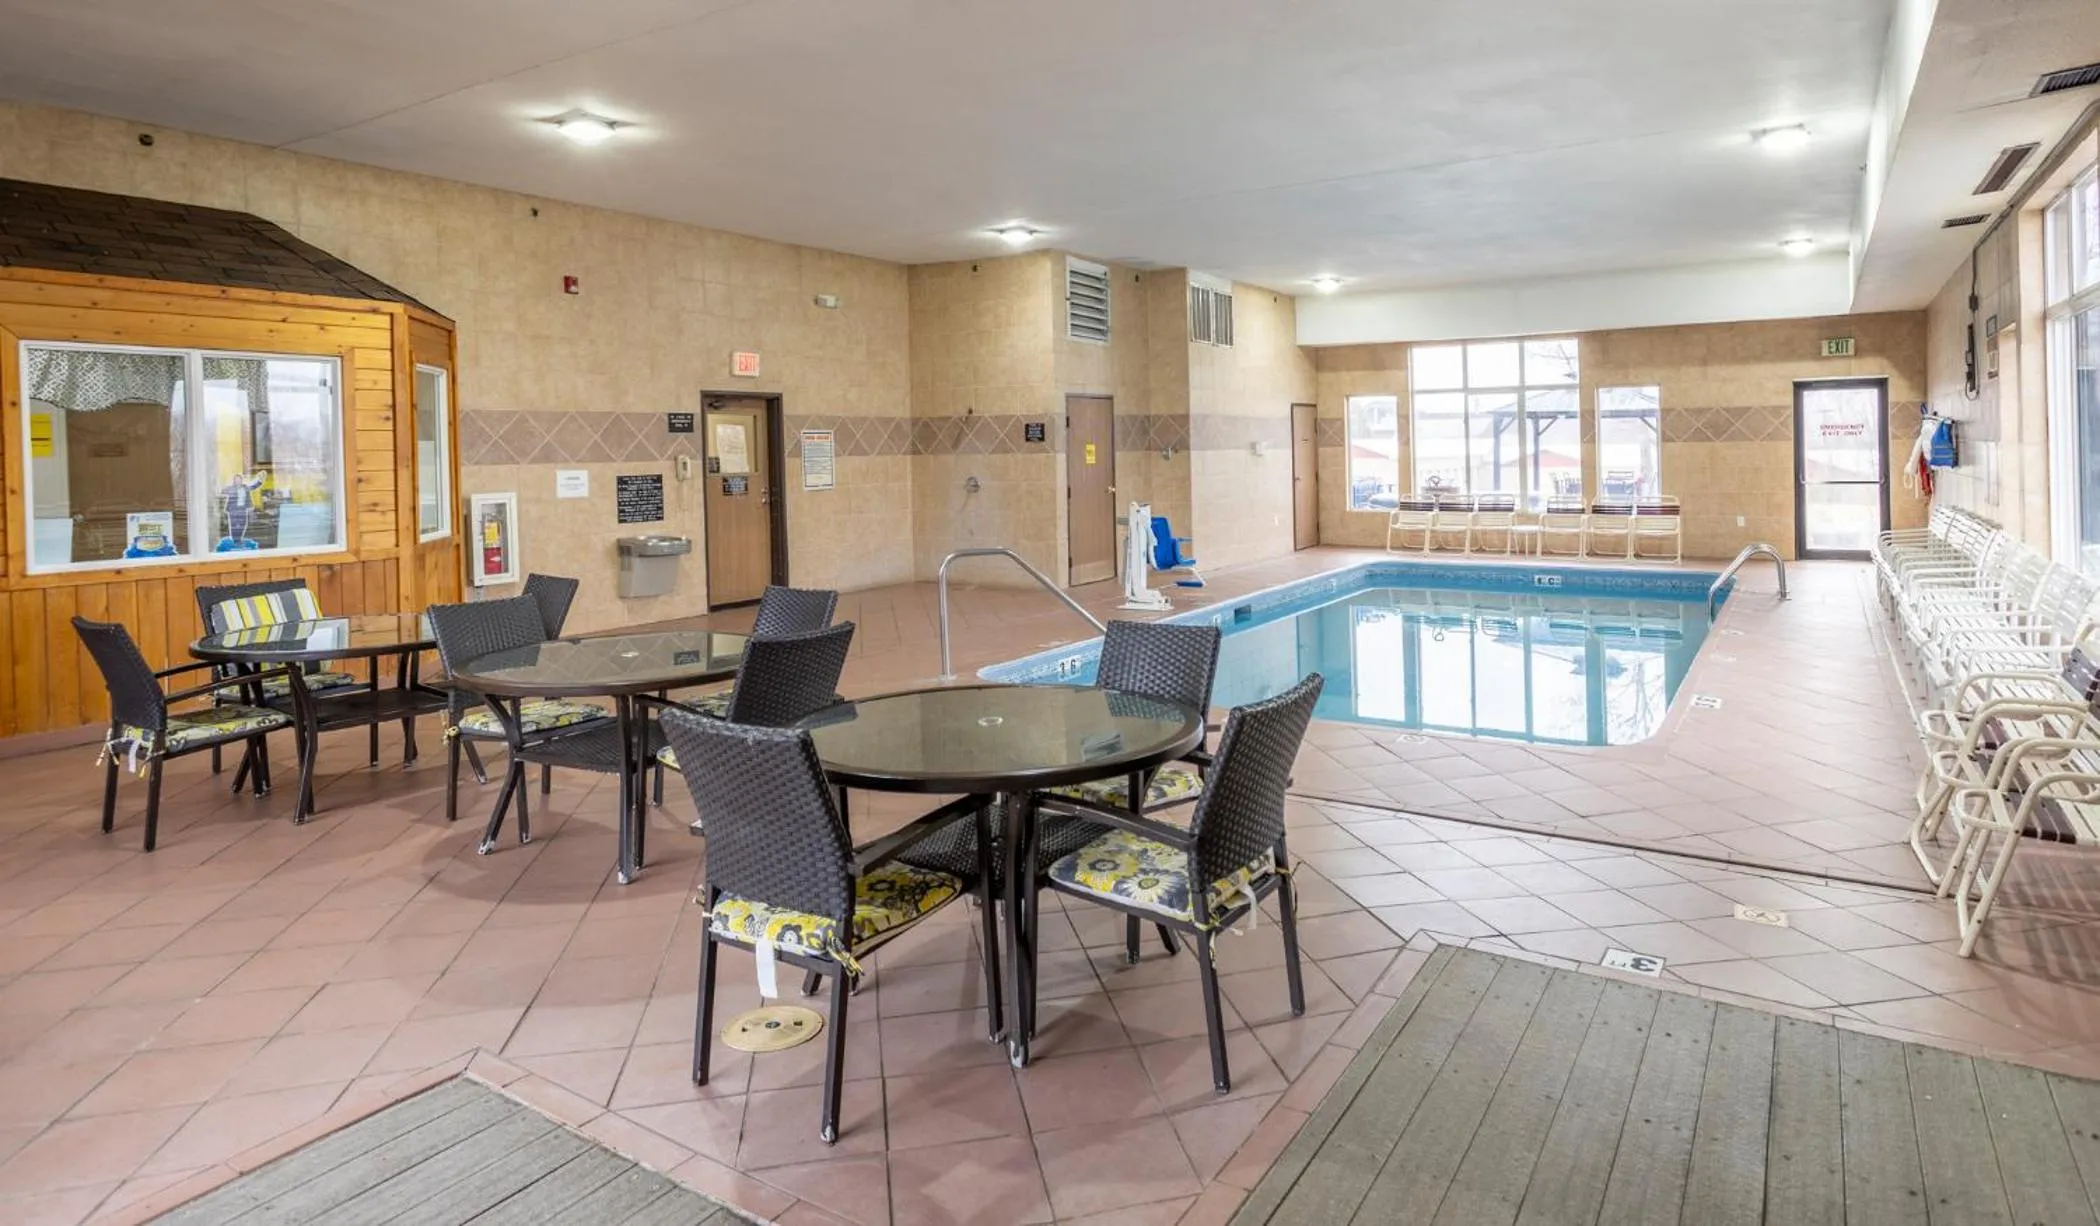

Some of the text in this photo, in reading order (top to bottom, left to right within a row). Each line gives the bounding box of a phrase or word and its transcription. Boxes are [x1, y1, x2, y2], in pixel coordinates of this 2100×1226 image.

[1827, 340, 1850, 355] EXIT
[738, 356, 756, 372] EXIT
[1630, 956, 1658, 973] 3
